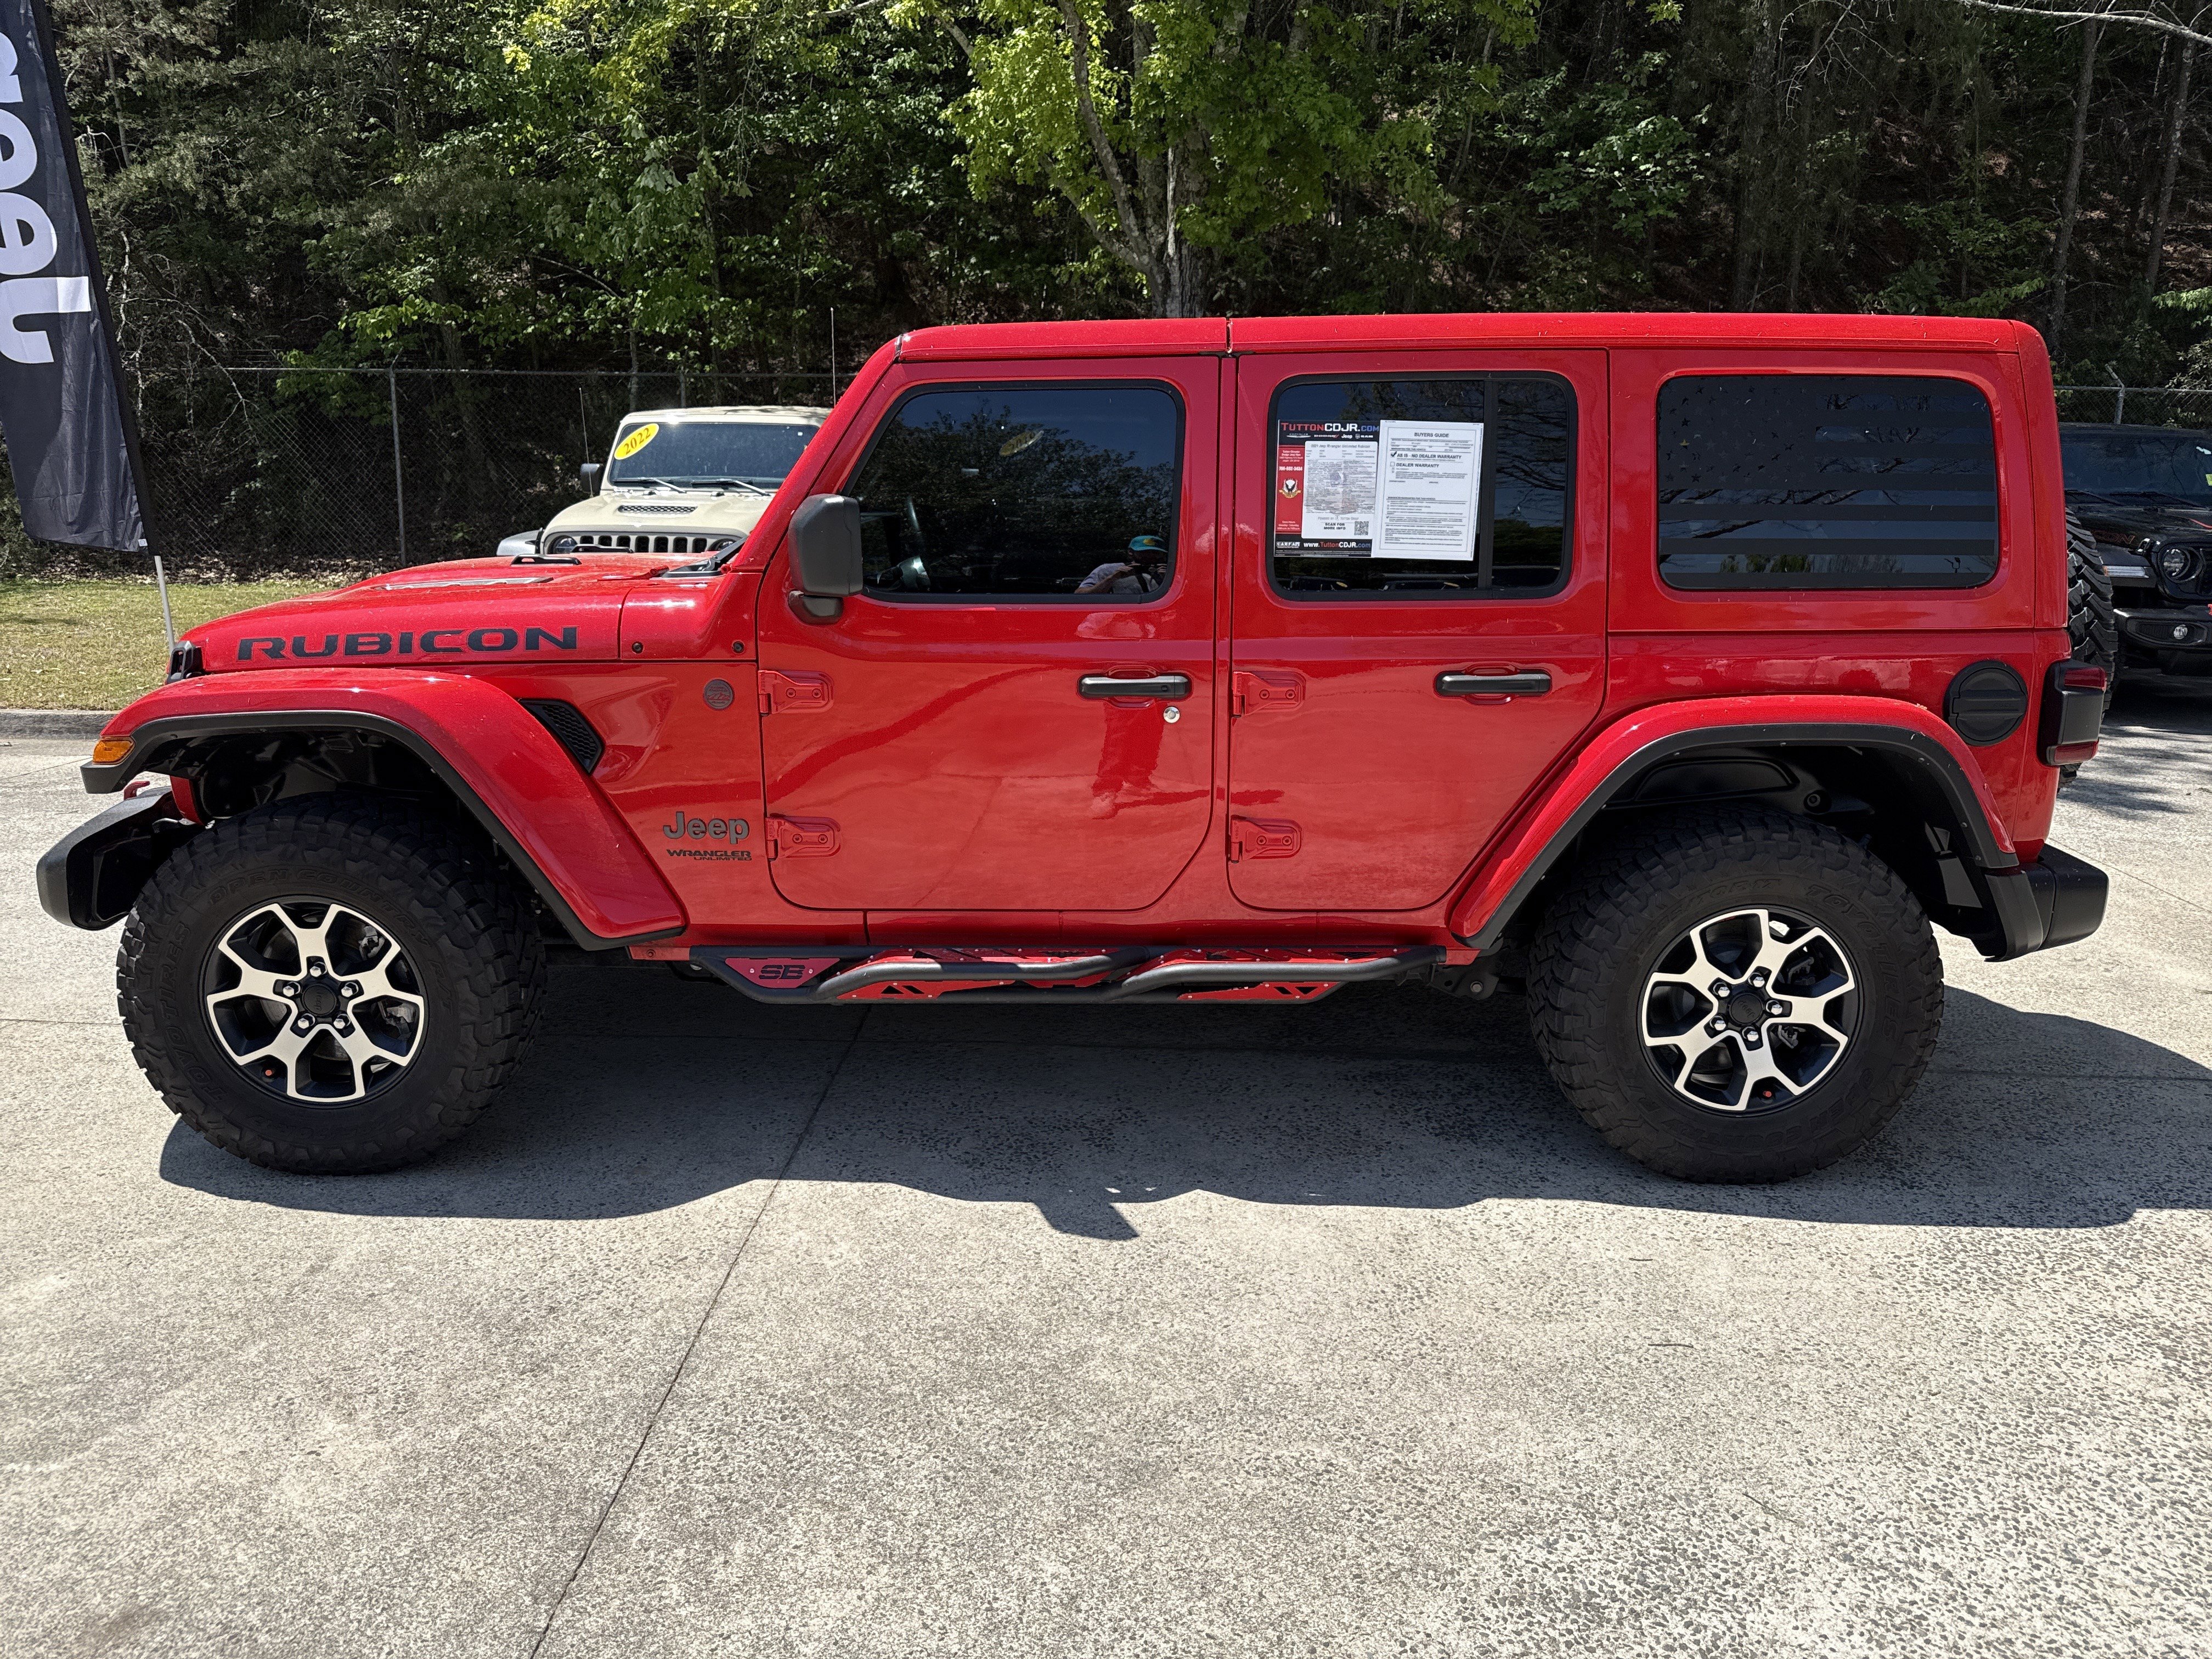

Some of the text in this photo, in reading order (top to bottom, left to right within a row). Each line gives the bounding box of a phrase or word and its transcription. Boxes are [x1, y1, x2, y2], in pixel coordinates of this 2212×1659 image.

[624, 428, 651, 455] 2022
[236, 625, 579, 662] RUBICON
[662, 811, 751, 845] Jeep
[666, 849, 752, 857] WRANGLER
[210, 868, 291, 904] OPEN
[298, 869, 432, 948] COUNTRY
[758, 964, 806, 980] SB
[1806, 884, 1901, 1037] TOYO TIRES
[160, 921, 226, 1101] TOYO TIRES
[1737, 1000, 1756, 1018] Jeep
